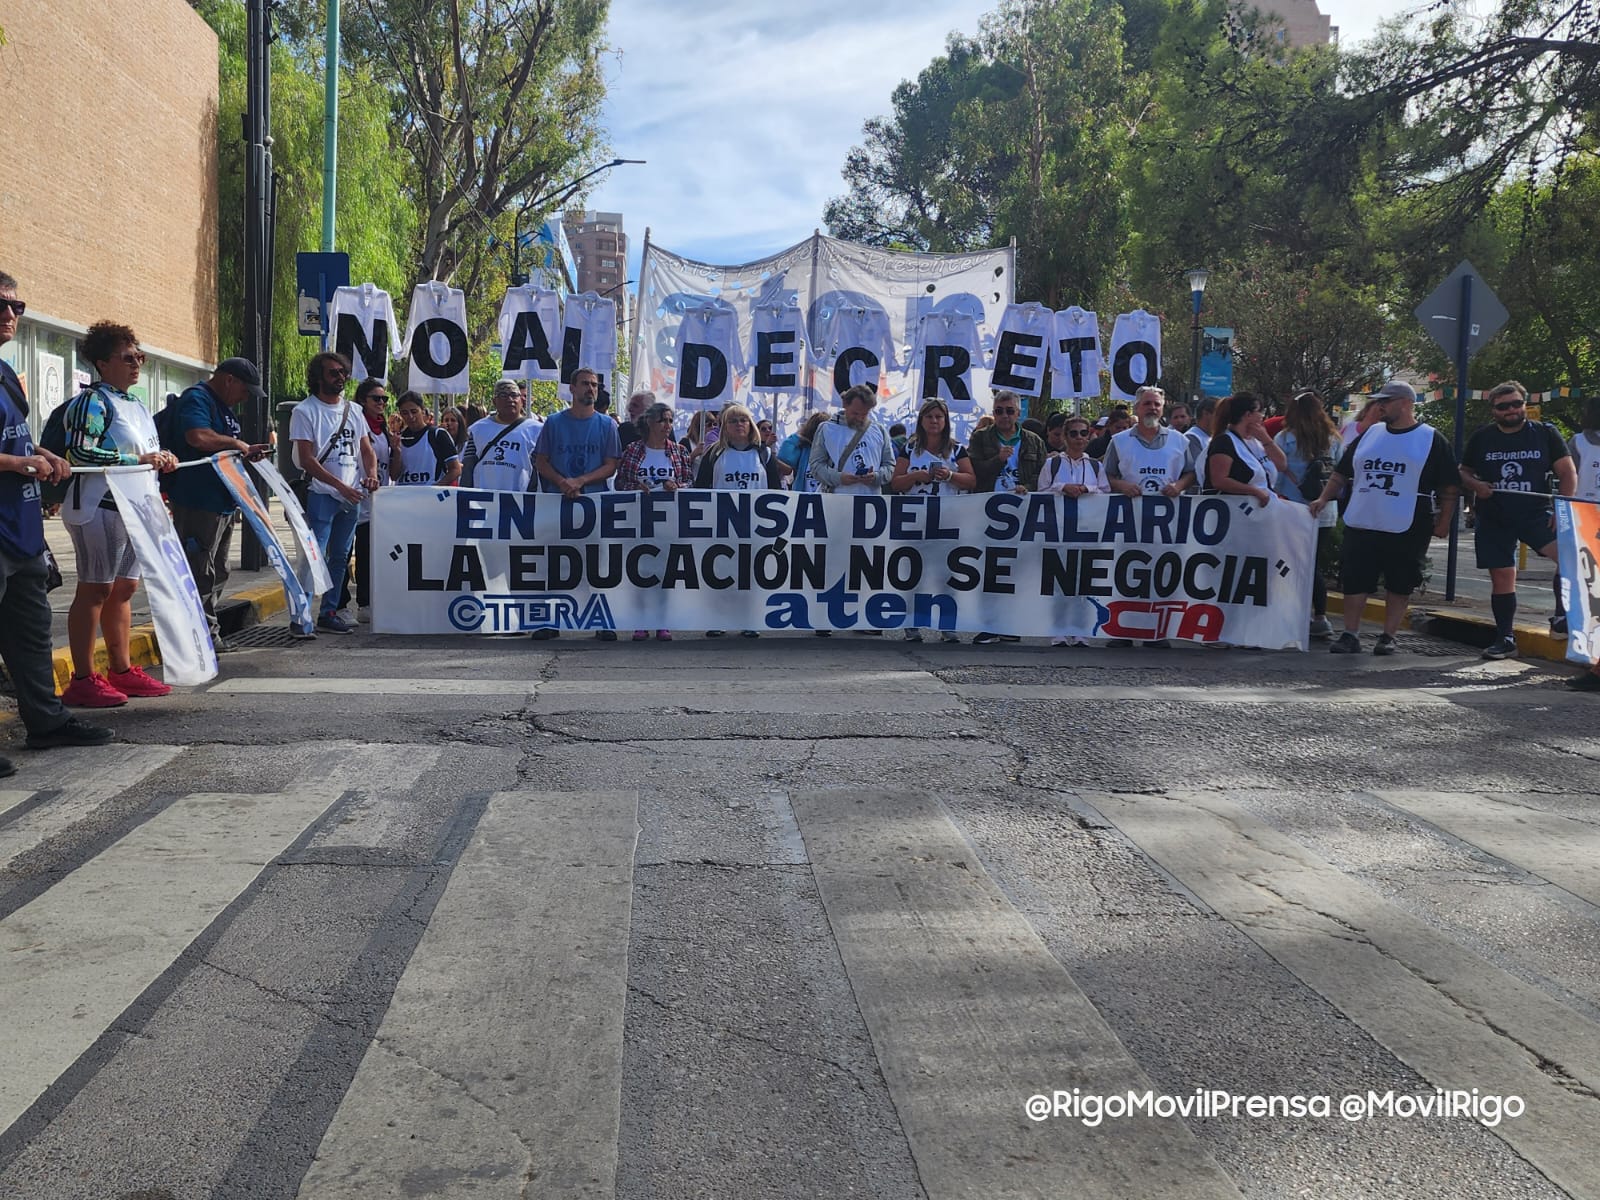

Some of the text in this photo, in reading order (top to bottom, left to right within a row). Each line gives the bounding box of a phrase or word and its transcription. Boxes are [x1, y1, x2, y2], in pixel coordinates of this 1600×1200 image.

[336, 312, 468, 379] NO
[502, 311, 604, 385] AL
[678, 331, 1158, 400] DECRETO
[725, 470, 760, 482] aten
[1139, 466, 1166, 475] aten
[1363, 458, 1406, 474] aten
[1486, 451, 1541, 461] SEGURIDAD
[560, 491, 828, 540] DEFENSA
[852, 495, 960, 540] DEL
[509, 537, 827, 592] EDUCACIÓN
[849, 544, 924, 591] NO
[946, 546, 1017, 595] SE
[448, 593, 617, 632] CTERA
[765, 571, 958, 631] aten
[1101, 600, 1225, 642] CTA
